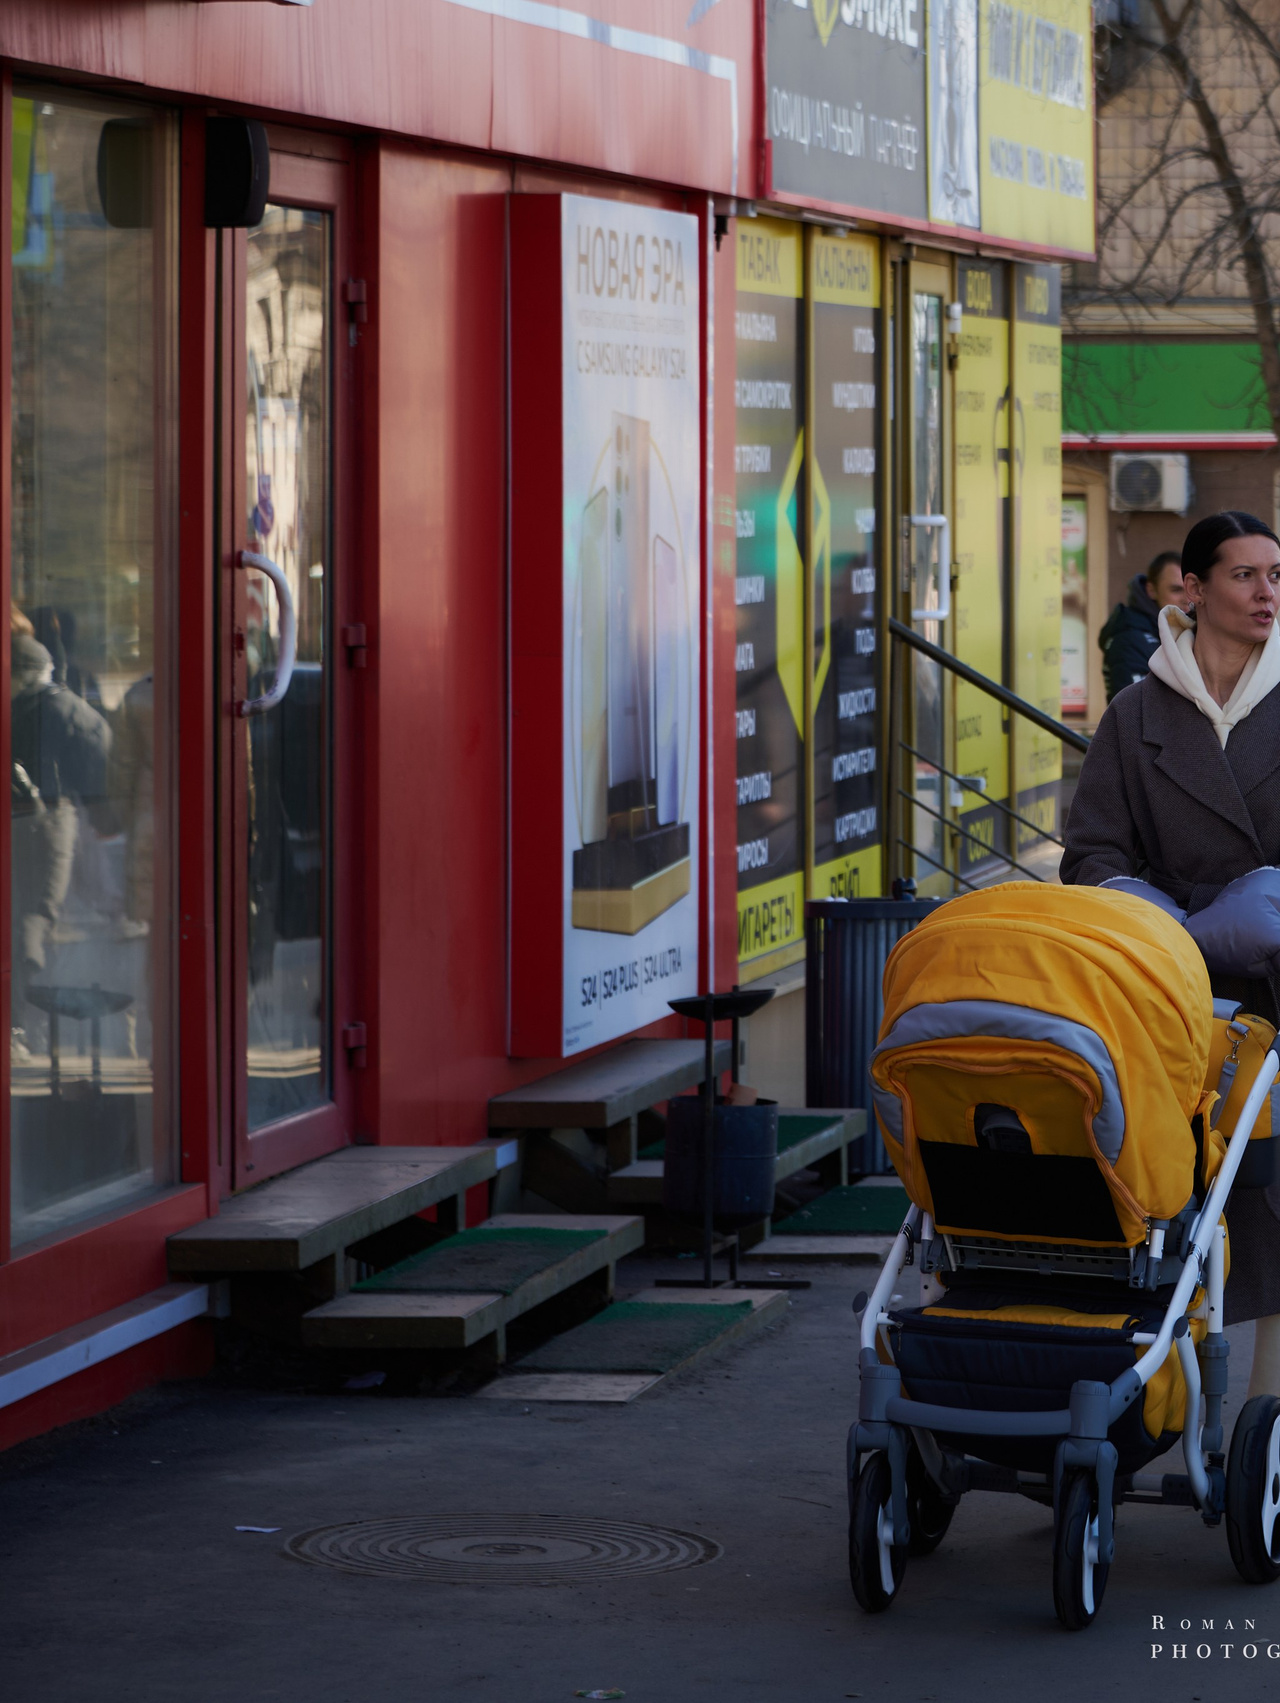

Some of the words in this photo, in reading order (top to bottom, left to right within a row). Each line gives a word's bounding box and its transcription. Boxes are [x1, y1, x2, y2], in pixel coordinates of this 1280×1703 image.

[772, 87, 866, 159] ОФИЦИАЛЬНЫЙ
[868, 115, 919, 171] ПАРТНЁР
[576, 224, 646, 301] НОВАЯ
[651, 236, 686, 306] ЭРА
[740, 234, 782, 284] ТАБАК
[815, 244, 871, 293] КАЛЬЯНЫ
[584, 341, 631, 376] SAMSUNG
[633, 345, 668, 378] GALAXY
[670, 348, 687, 379] S24
[838, 688, 876, 720] ЖИДКОСТИ
[832, 747, 877, 782] ИСПАРИТЕЛИ
[835, 807, 877, 843] КАРТРИДЖИ
[738, 892, 796, 955] ИГАРЕТЫ
[581, 975, 597, 1007] S24
[603, 968, 618, 1000] S24
[619, 961, 639, 994] PLUS
[643, 954, 658, 984] S24
[659, 946, 682, 980] ULTRA
